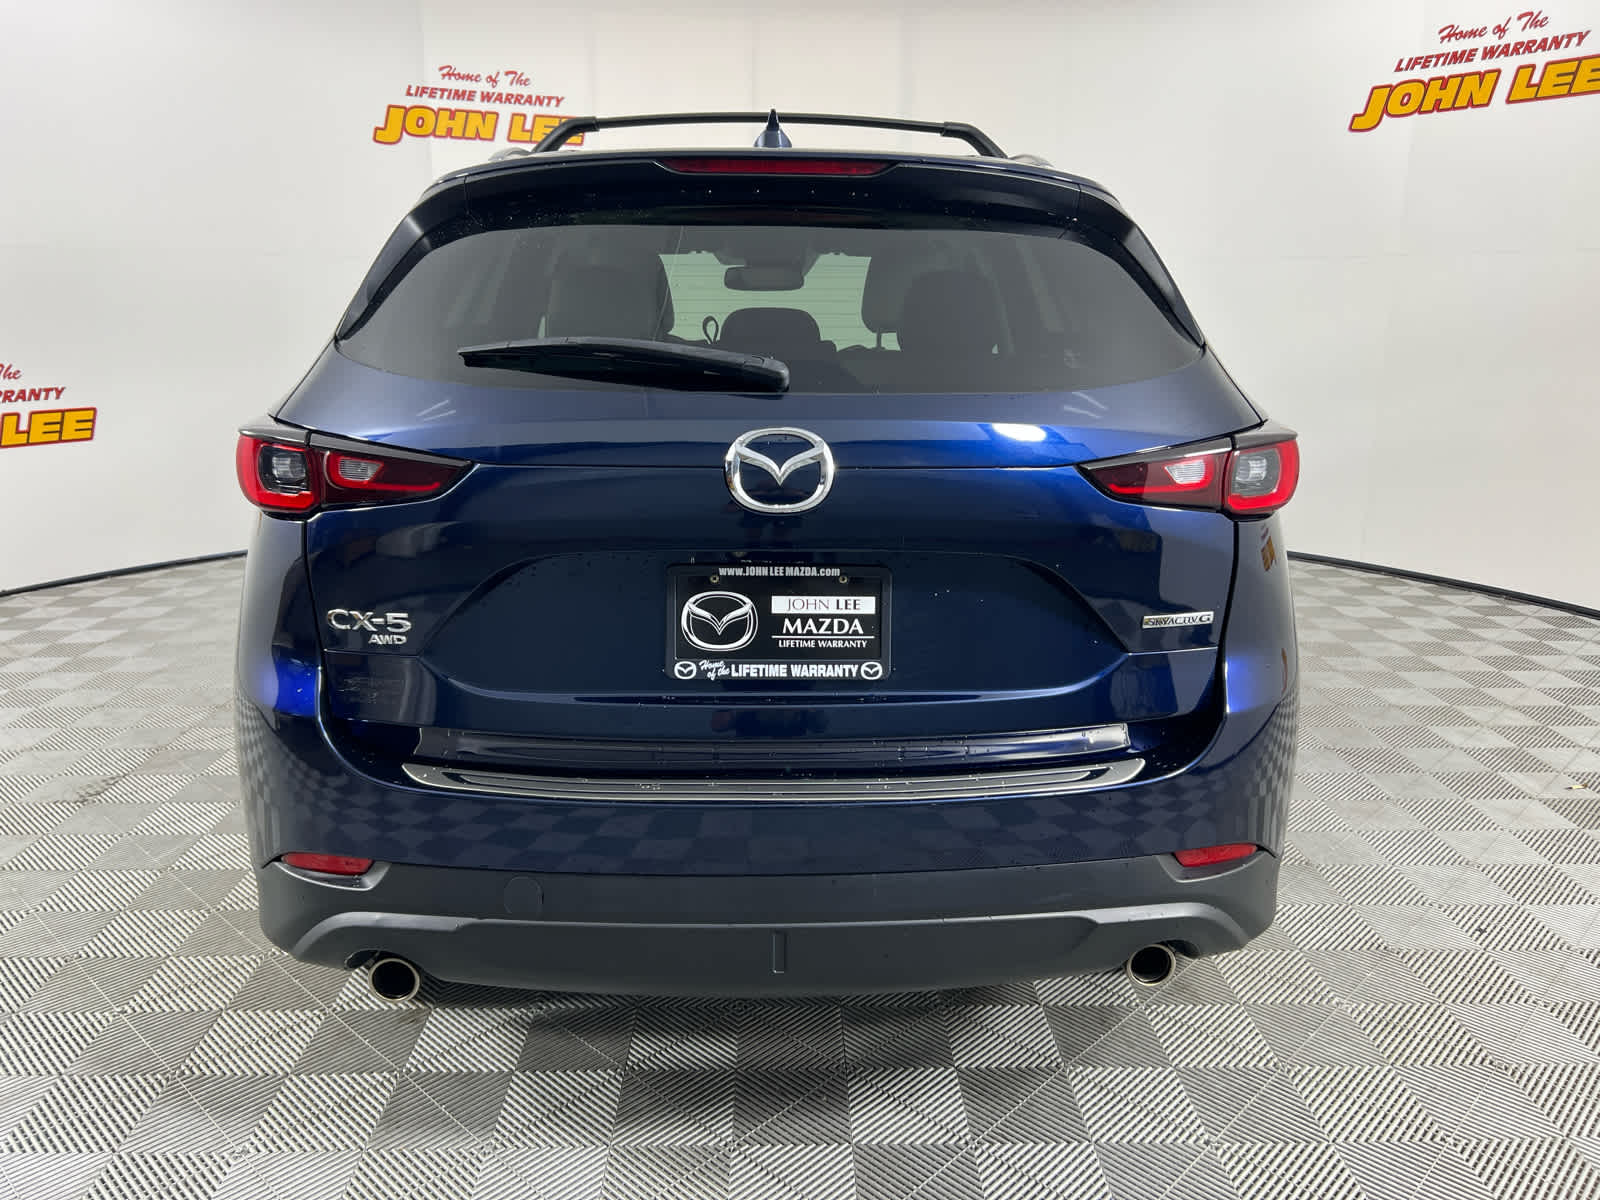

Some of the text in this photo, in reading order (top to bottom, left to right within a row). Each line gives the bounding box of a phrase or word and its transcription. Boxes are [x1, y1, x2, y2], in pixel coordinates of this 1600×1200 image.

[1438, 10, 1550, 44] Home of The
[1394, 30, 1592, 72] LIFETIME WARRANTY
[438, 64, 531, 86] Home of The
[405, 84, 565, 108] LIFETIME WARRANTY
[1348, 53, 1600, 132] JOHN LEE
[373, 104, 499, 145] JOHN
[0, 363, 22, 380] he
[0, 386, 66, 403] RANTY
[0, 406, 97, 449] LEE
[770, 566, 784, 576] LEE
[785, 566, 840, 576] MAZDA.com
[788, 598, 861, 611] JOHN LEE
[327, 608, 412, 632] CX-5
[782, 618, 864, 634] MAZDA
[368, 634, 407, 644] AWD
[778, 640, 868, 648] LIFETIME WARRANTY
[698, 659, 724, 670] Home
[707, 664, 730, 680] of the
[731, 664, 858, 678] LIFETIME WARRANTY
